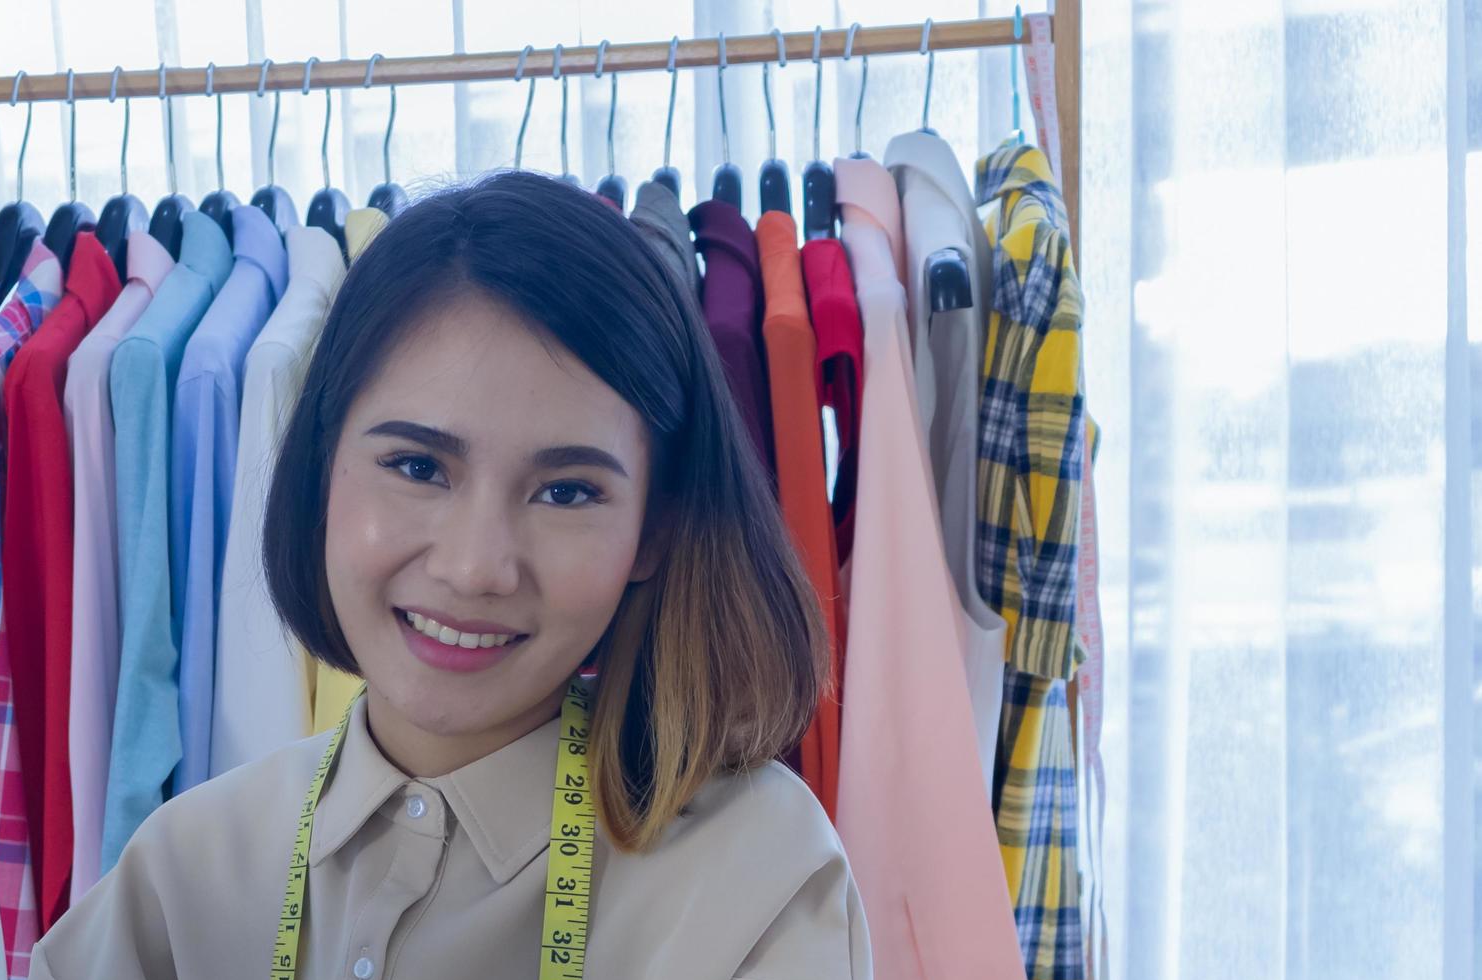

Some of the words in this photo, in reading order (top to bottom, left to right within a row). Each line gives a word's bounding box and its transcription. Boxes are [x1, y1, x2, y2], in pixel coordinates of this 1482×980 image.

[570, 684, 589, 714] 27
[568, 726, 588, 756] 28
[564, 775, 585, 805] 29
[560, 824, 580, 856] 30
[294, 852, 305, 881] 17
[555, 876, 576, 908] 31
[285, 903, 299, 933] 16
[551, 930, 572, 964] 32
